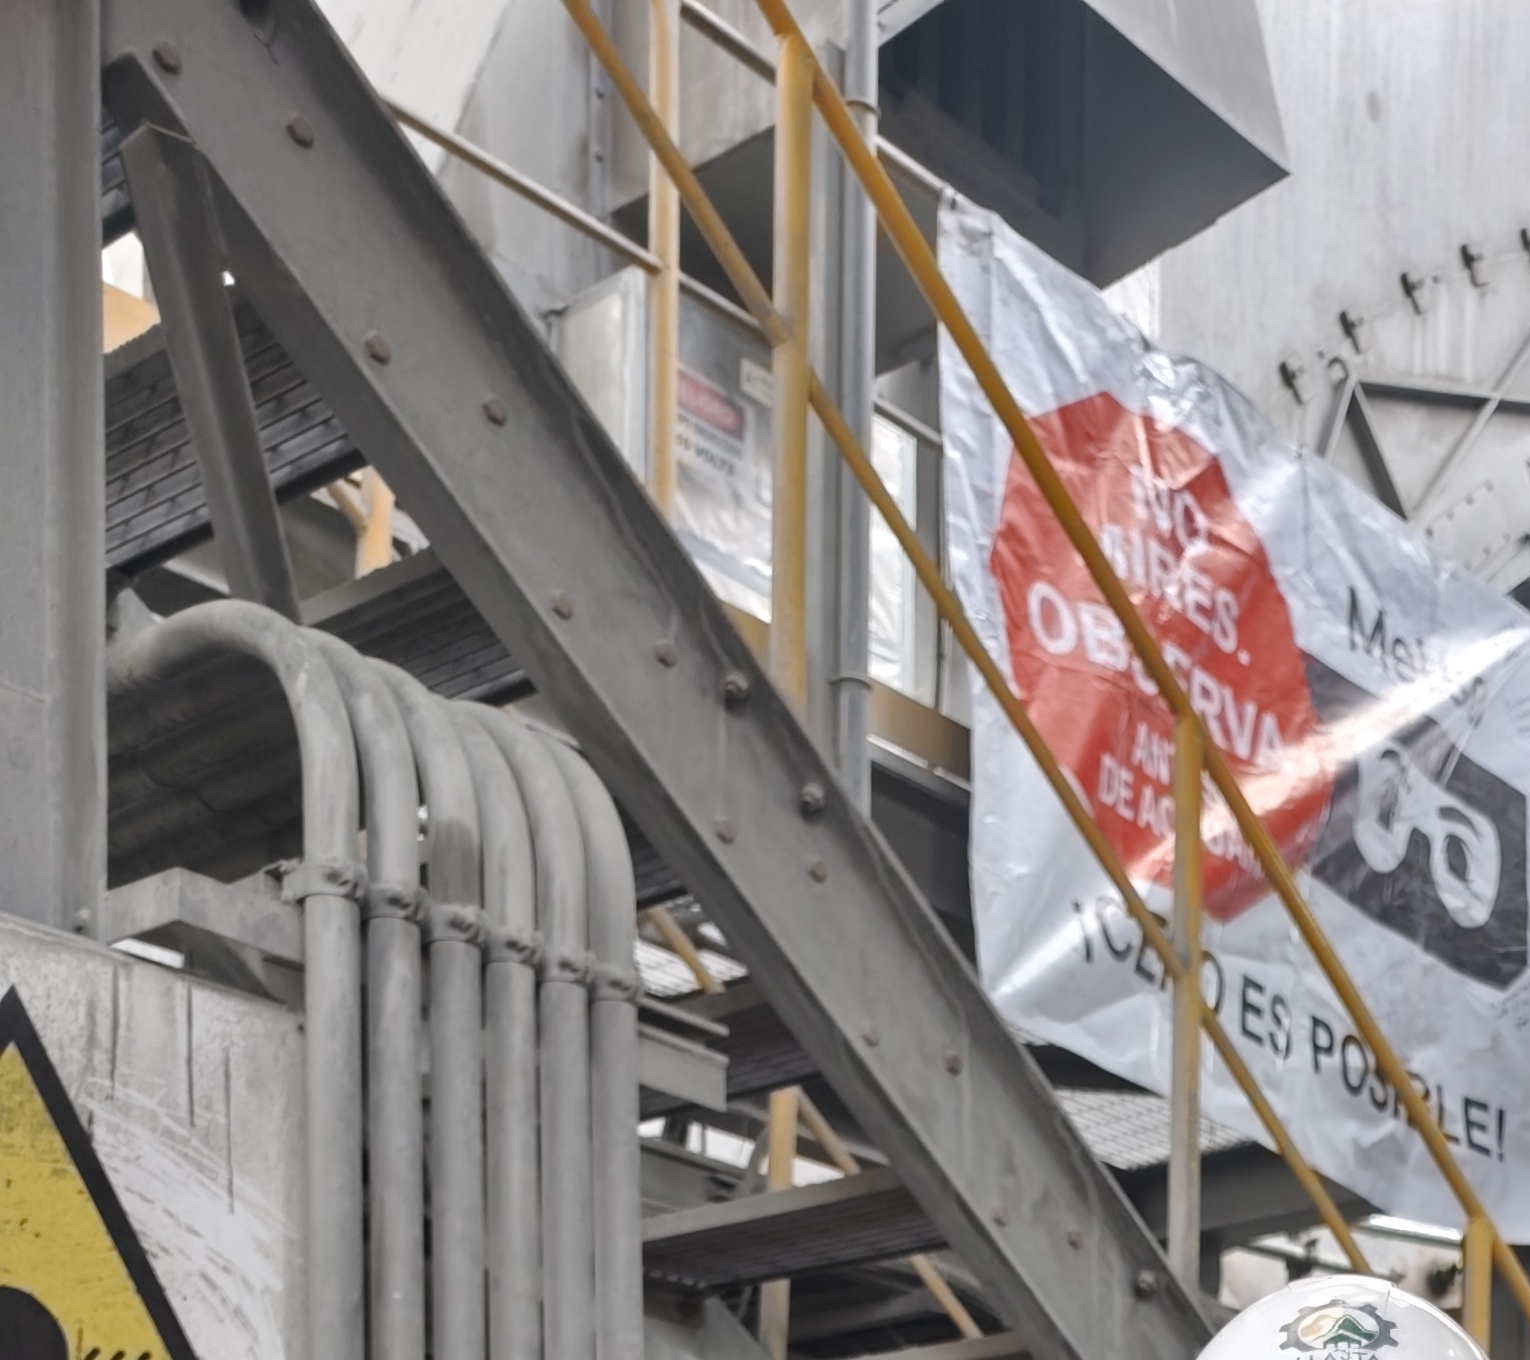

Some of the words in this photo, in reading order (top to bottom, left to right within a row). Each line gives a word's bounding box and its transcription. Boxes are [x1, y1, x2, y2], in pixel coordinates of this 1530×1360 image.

[1129, 464, 1209, 556] NO
[1099, 752, 1136, 823] DE
[1073, 900, 1226, 1018] ¡CEO
[1240, 975, 1291, 1060] ES
